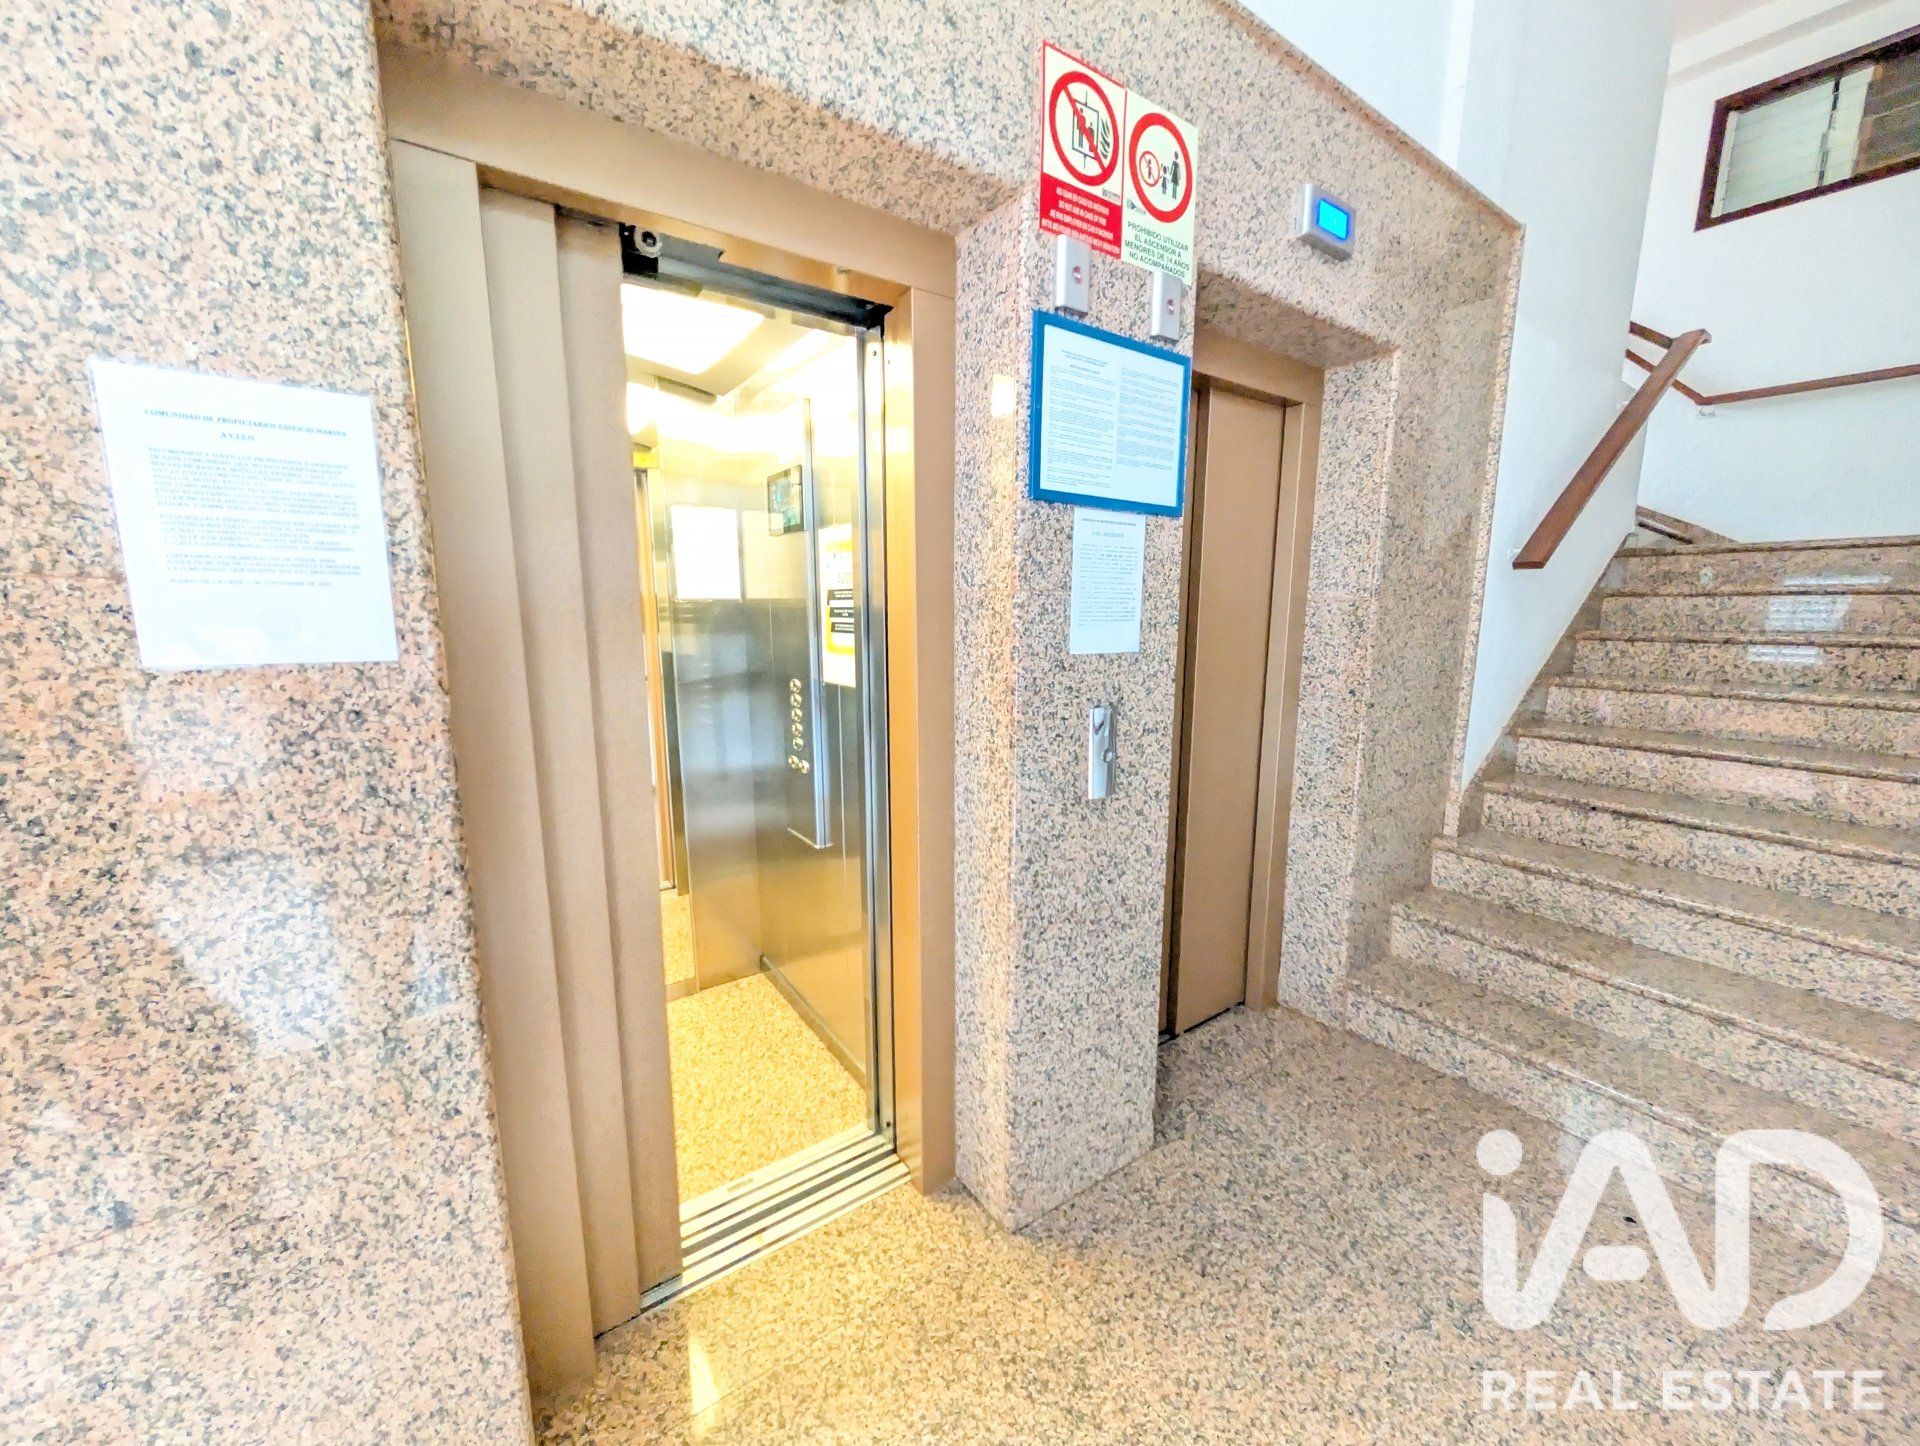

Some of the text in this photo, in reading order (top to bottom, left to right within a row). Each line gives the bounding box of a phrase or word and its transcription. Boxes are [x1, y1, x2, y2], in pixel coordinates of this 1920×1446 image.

[1127, 221, 1189, 252] PROHIBIDO UTILIZAR
[1135, 234, 1142, 243] EL
[1144, 238, 1176, 256] ASCENSOR
[1125, 239, 1190, 271] MENORES DE 14 AÑOS
[1128, 251, 1185, 278] NO ACOMPAÑADOS
[144, 408, 202, 421] COMUNIDAD
